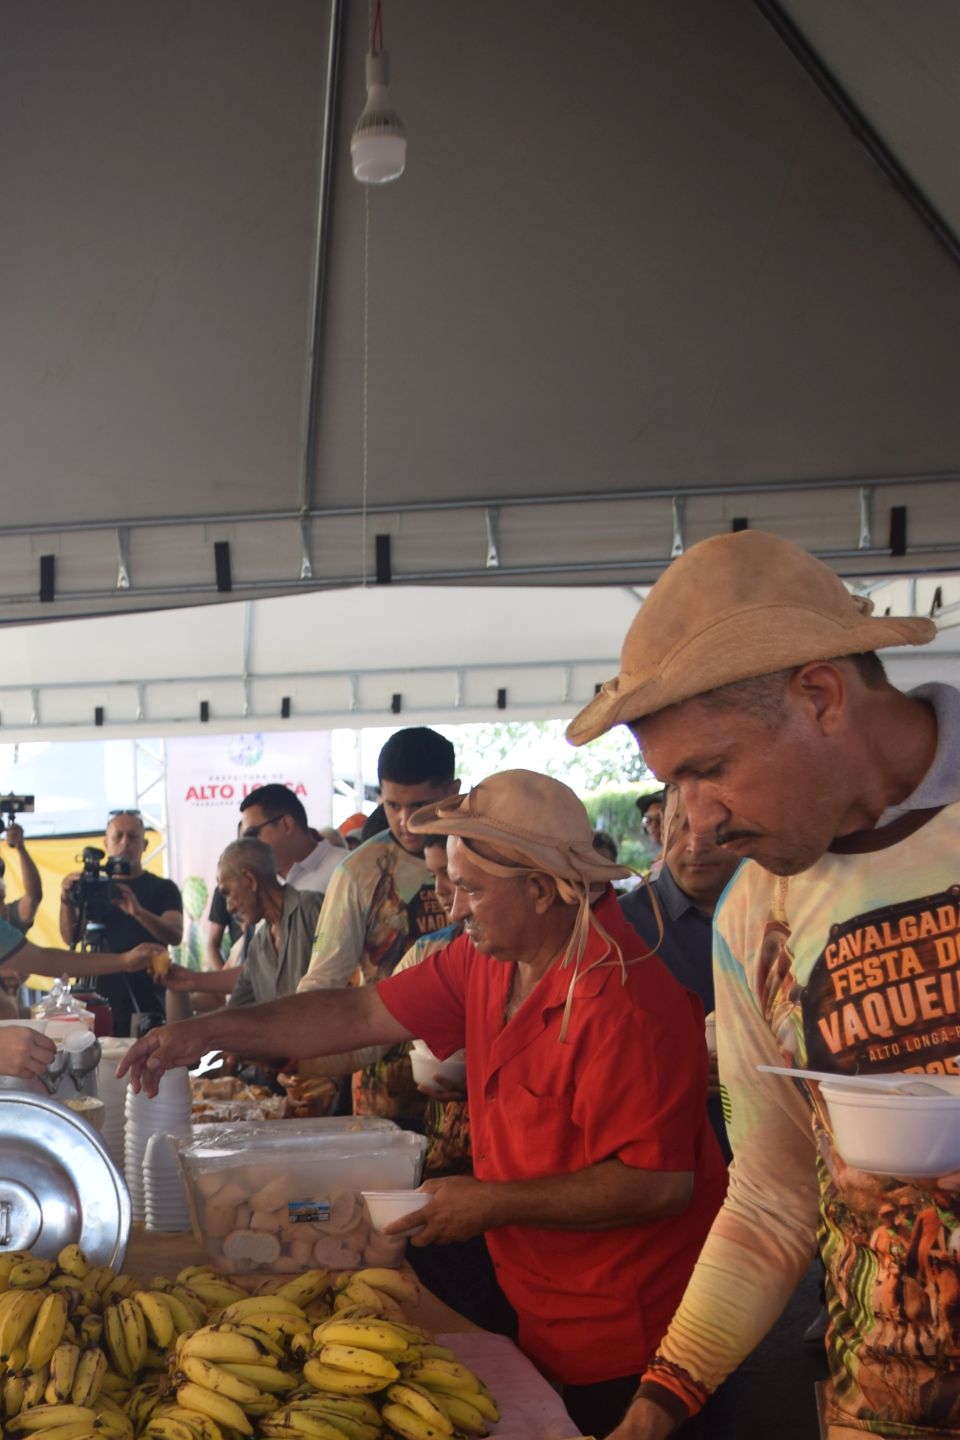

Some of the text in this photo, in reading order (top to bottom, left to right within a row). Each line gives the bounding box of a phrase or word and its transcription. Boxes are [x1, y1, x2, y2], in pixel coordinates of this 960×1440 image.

[185, 784, 235, 800] ALTO
[825, 904, 960, 970] CAVALGAD
[831, 934, 960, 1001] FESTA D
[818, 970, 960, 1055] VAQUEI
[869, 1042, 900, 1062] ALTO
